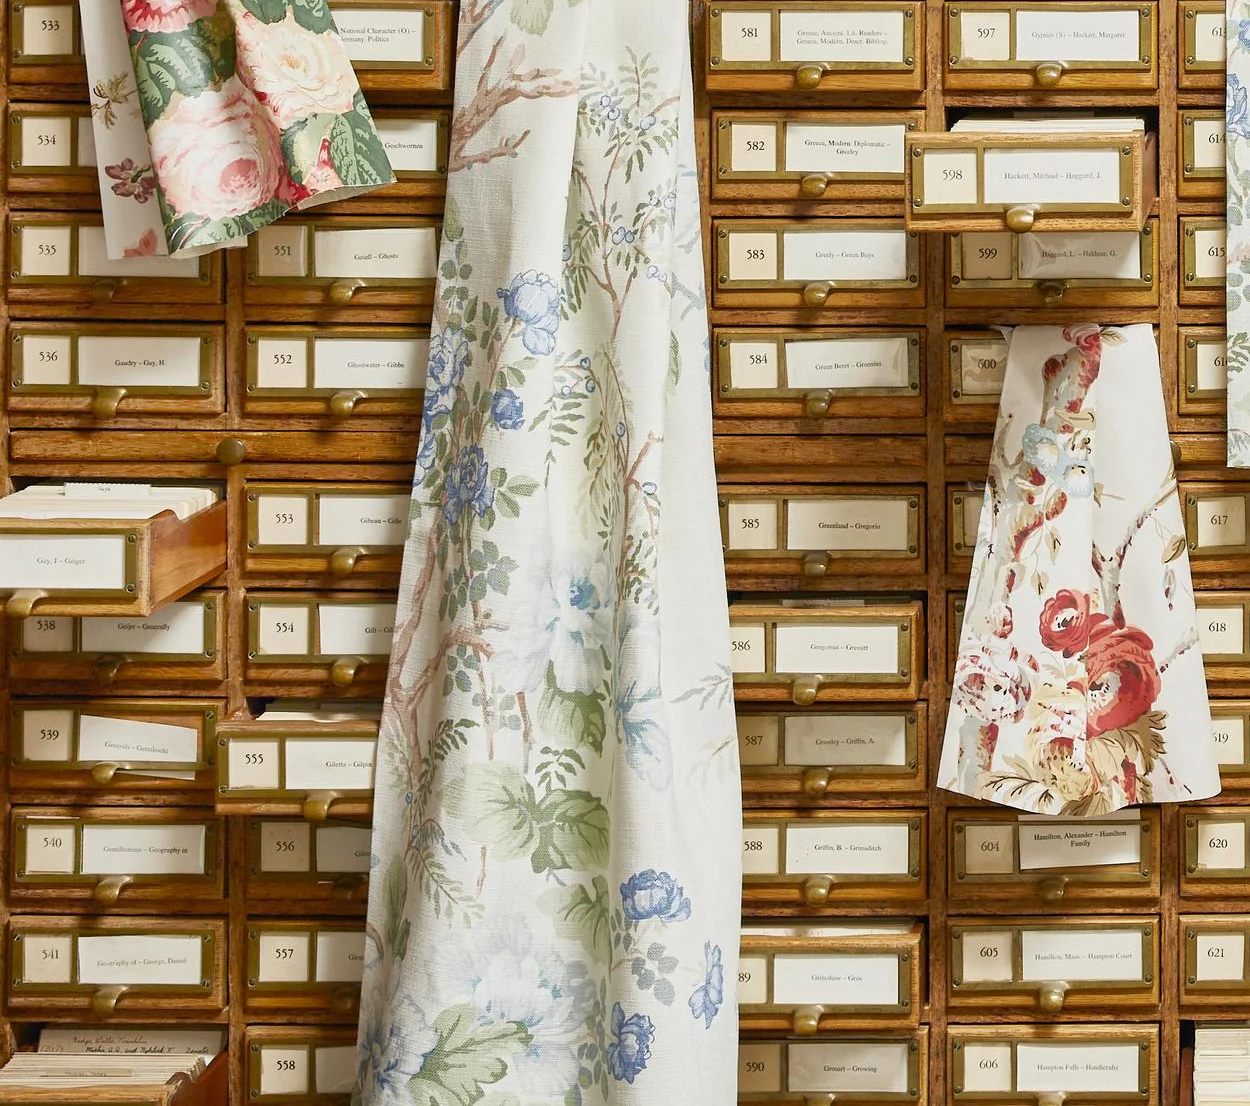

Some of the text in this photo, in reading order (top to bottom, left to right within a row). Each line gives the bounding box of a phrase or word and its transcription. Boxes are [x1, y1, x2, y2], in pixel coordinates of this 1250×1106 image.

[41, 20, 60, 32] 533
[741, 27, 758, 39] 581
[977, 27, 996, 39] 597
[37, 134, 57, 146] 534
[746, 140, 765, 152] 582
[835, 148, 859, 157] Greeley
[942, 169, 963, 181] 598
[38, 244, 57, 256] 535
[273, 245, 292, 257] 551
[746, 249, 765, 261] 583
[978, 247, 998, 260] 599
[1207, 246, 1226, 257] 615
[39, 350, 58, 363] 536
[273, 354, 292, 365] 552
[749, 353, 768, 365] 584
[977, 358, 997, 370] 600
[275, 513, 294, 524] 553
[741, 518, 760, 530] 585
[1210, 514, 1229, 526] 617
[818, 521, 881, 531] Greenland Gregorio
[36, 619, 56, 631] 538
[141, 622, 171, 632] Generally
[275, 622, 294, 633] 554
[1208, 621, 1227, 632] 618
[731, 639, 751, 652] 586
[40, 729, 60, 741] 539
[744, 735, 763, 747] 587
[245, 753, 264, 765] 555
[1063, 830, 1094, 841] Alexander
[1099, 829, 1127, 838] Hamilton
[43, 837, 63, 848] 540
[276, 840, 295, 853] 556
[743, 840, 763, 852] 588
[980, 840, 1000, 852] 604
[1070, 839, 1091, 848] Family
[1208, 837, 1228, 849] 620
[42, 948, 59, 960] 541
[275, 948, 294, 960] 557
[979, 946, 999, 958] 605
[1207, 947, 1224, 958] 621
[276, 1060, 296, 1071] 558
[746, 1061, 765, 1073] 590
[851, 1065, 878, 1074] Growing
[979, 1058, 999, 1069] 606
